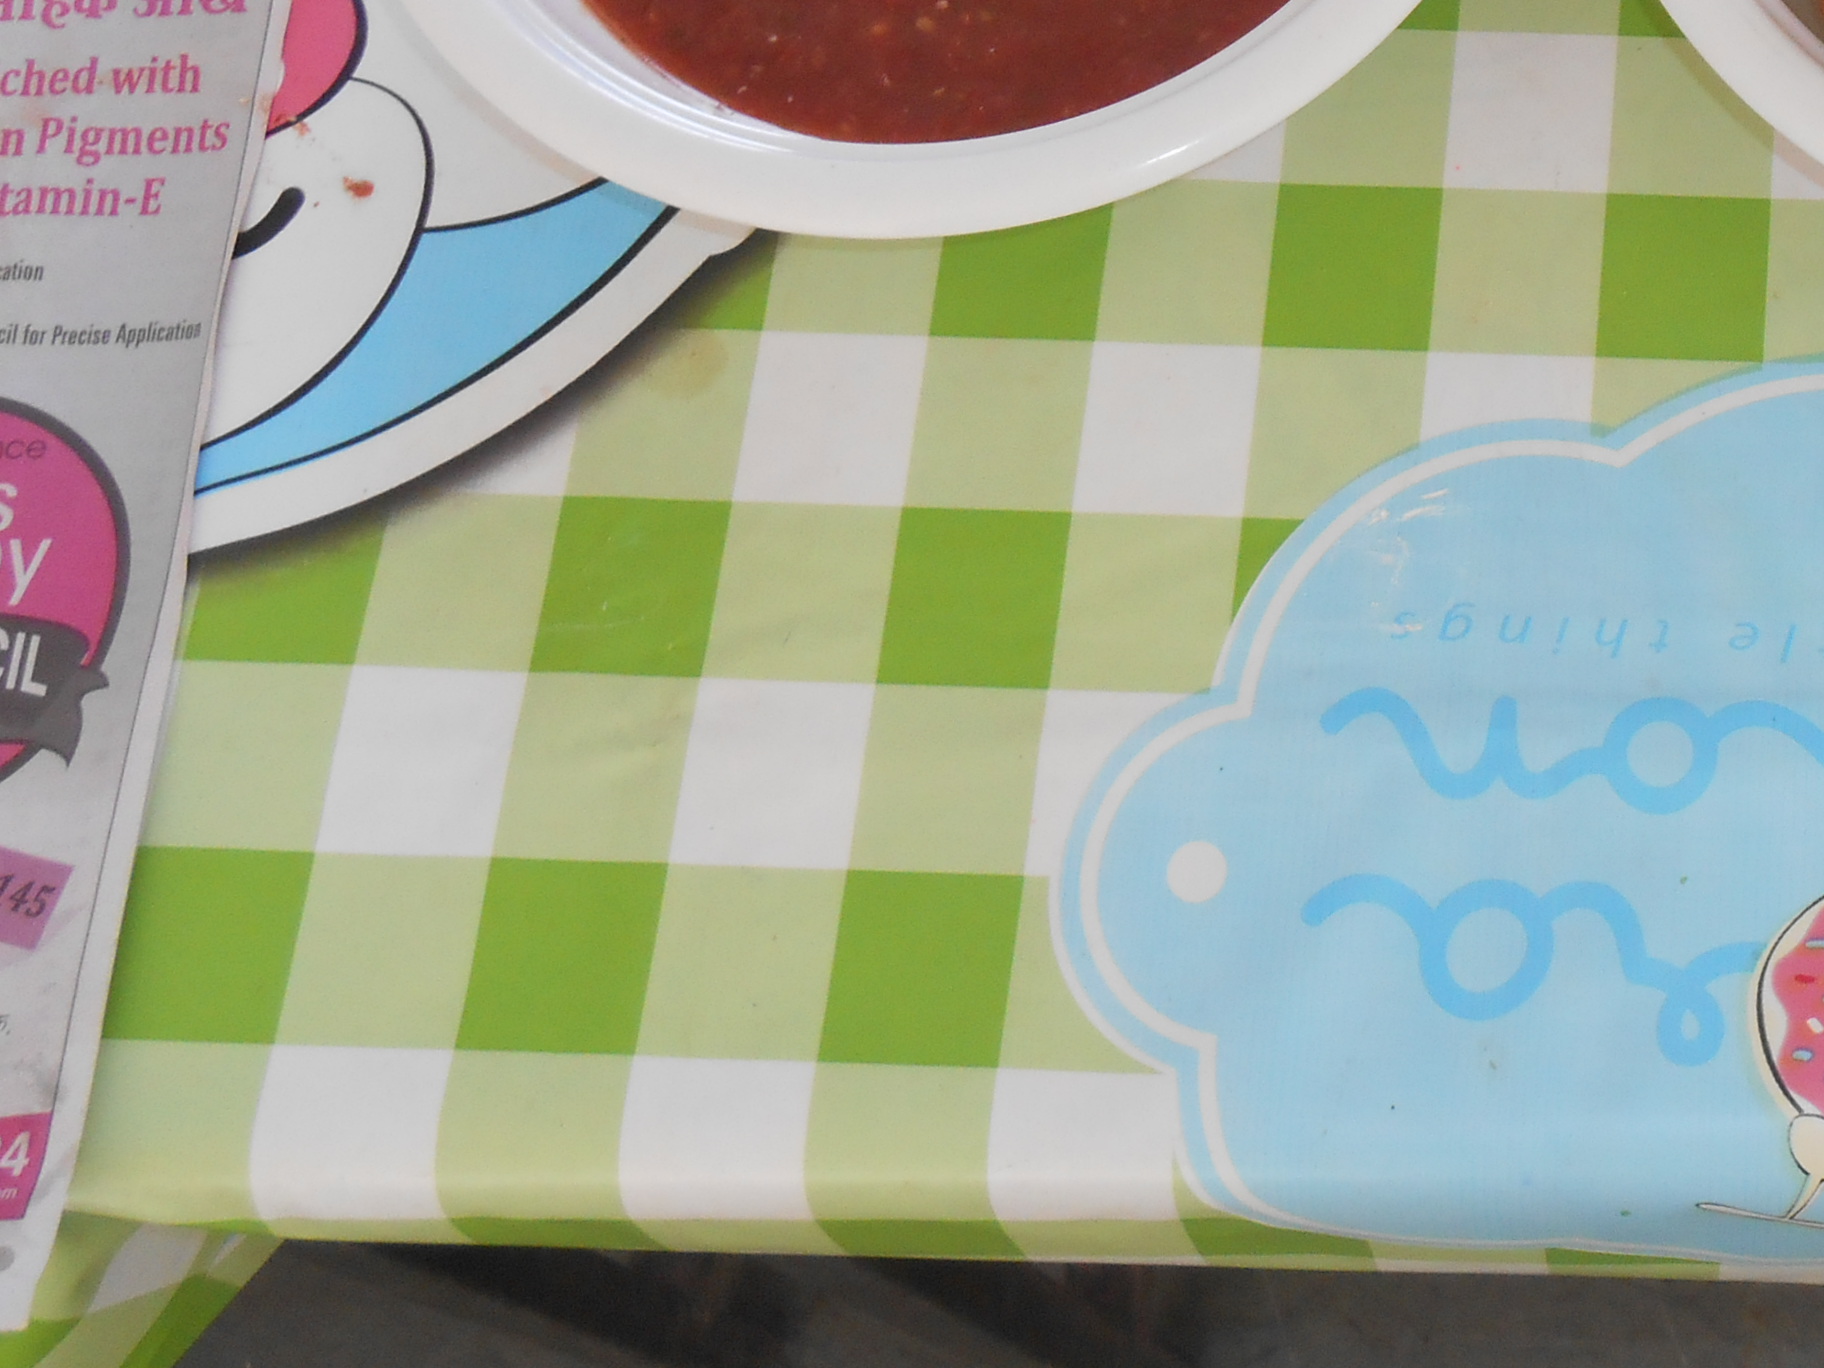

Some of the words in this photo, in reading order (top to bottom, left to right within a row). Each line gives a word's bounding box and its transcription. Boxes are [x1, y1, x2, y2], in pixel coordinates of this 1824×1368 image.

[0, 56, 98, 96] ched
[112, 51, 202, 95] with
[36, 113, 231, 167] Pigments
[0, 175, 167, 217] tamin-E
[23, 323, 47, 346] for
[51, 323, 112, 346] Precise
[115, 319, 202, 349] Application
[0, 439, 47, 461] ce
[0, 537, 52, 607] y
[1388, 602, 1671, 660] things
[0, 1130, 31, 1178] 4
